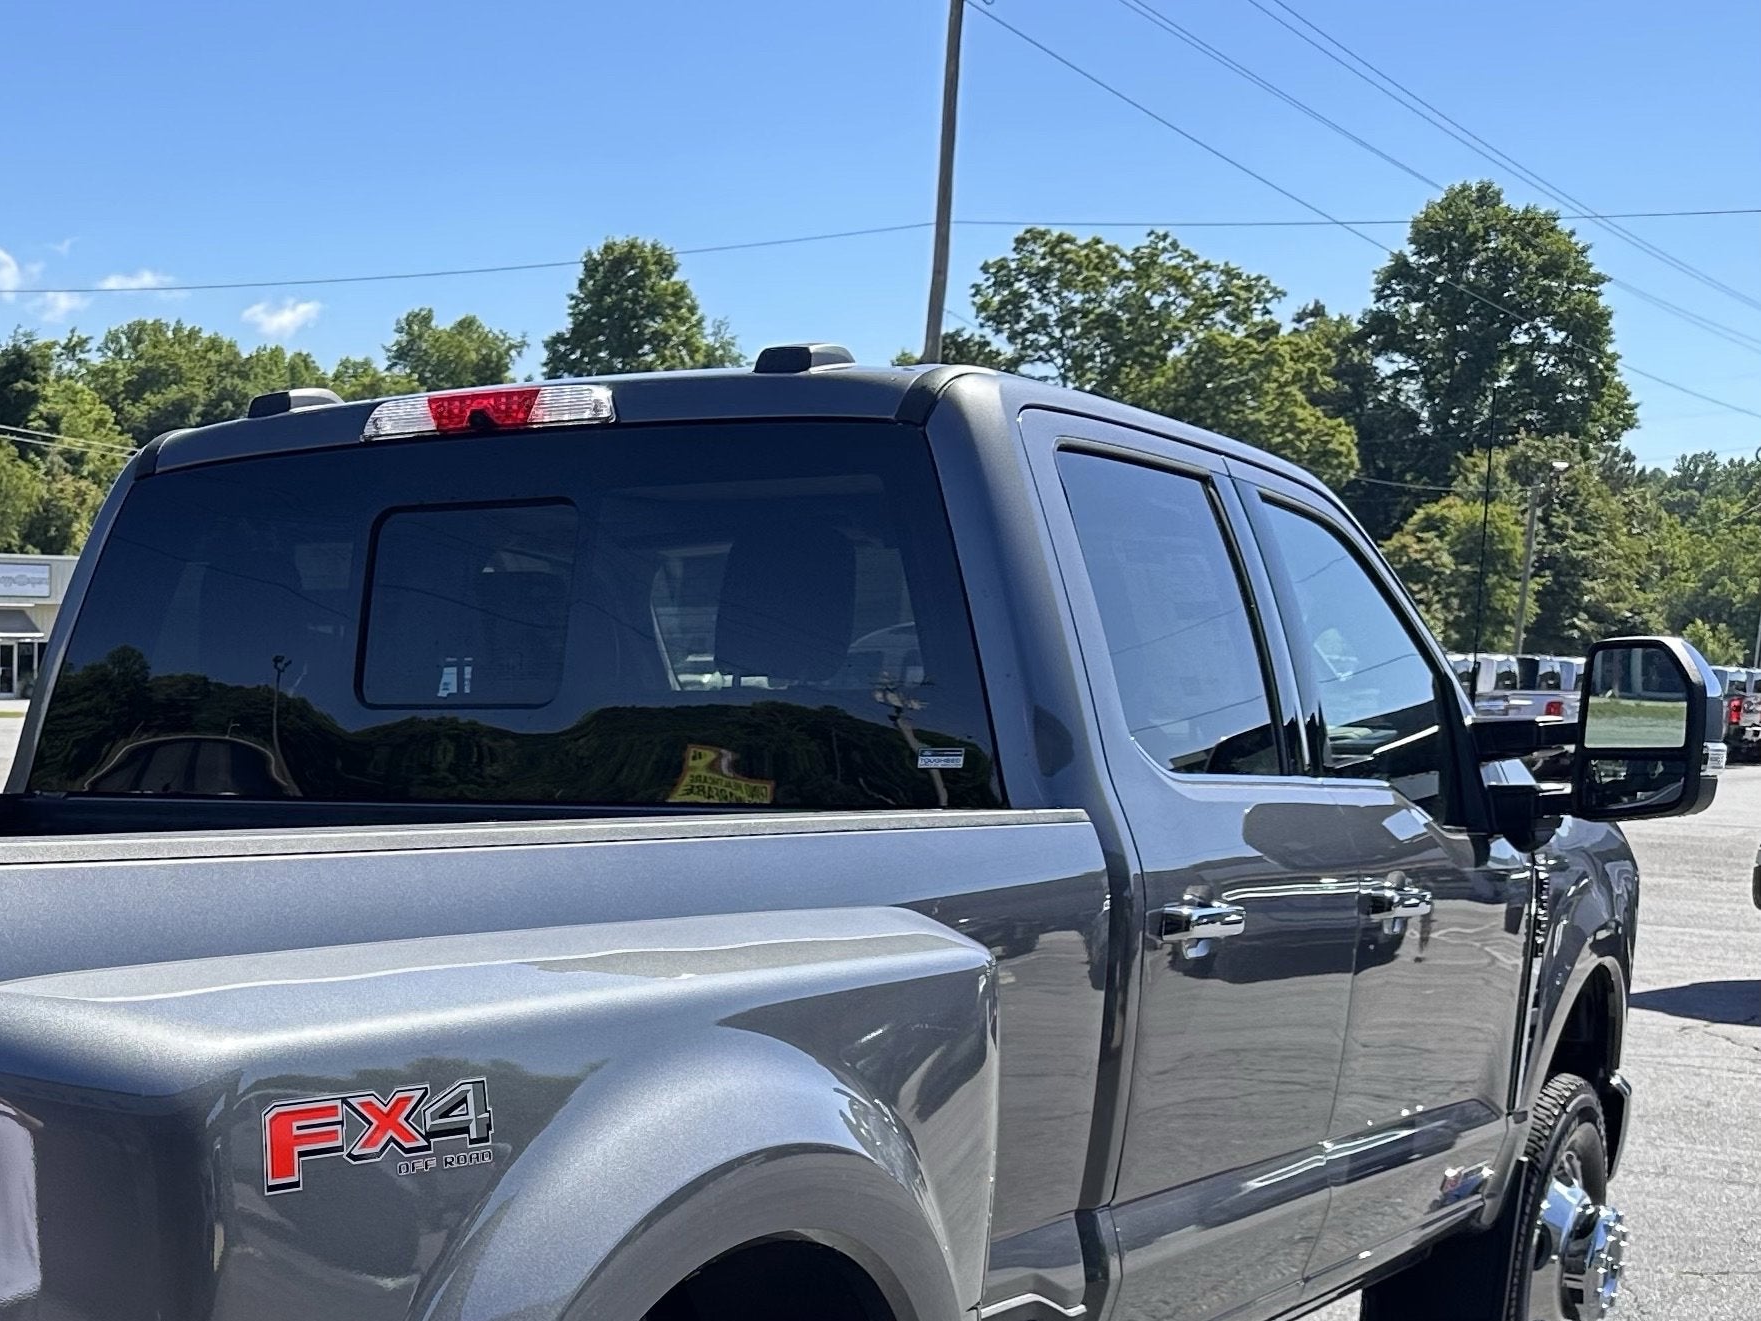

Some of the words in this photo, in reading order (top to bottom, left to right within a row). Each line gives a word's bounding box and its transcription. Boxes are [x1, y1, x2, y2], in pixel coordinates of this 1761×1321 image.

[261, 1076, 495, 1197] FX4
[397, 1158, 437, 1176] OFF
[443, 1149, 494, 1169] ROAD
